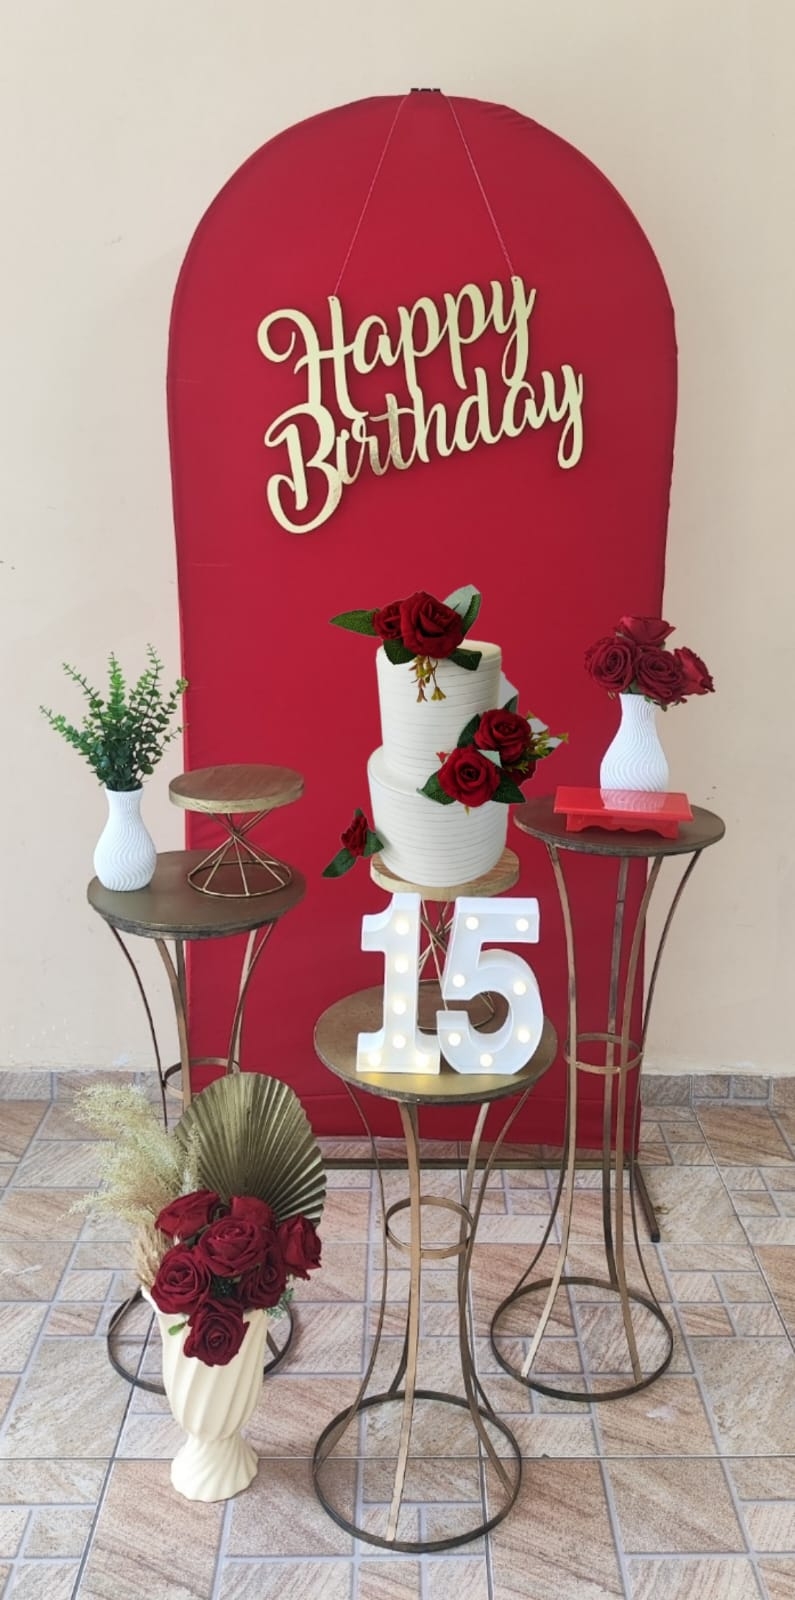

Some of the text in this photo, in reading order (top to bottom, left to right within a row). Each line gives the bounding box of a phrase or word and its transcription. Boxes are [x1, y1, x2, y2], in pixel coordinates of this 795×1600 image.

[257, 275, 537, 419] Happy
[264, 364, 583, 534] Birthday
[356, 892, 544, 1075] 15
